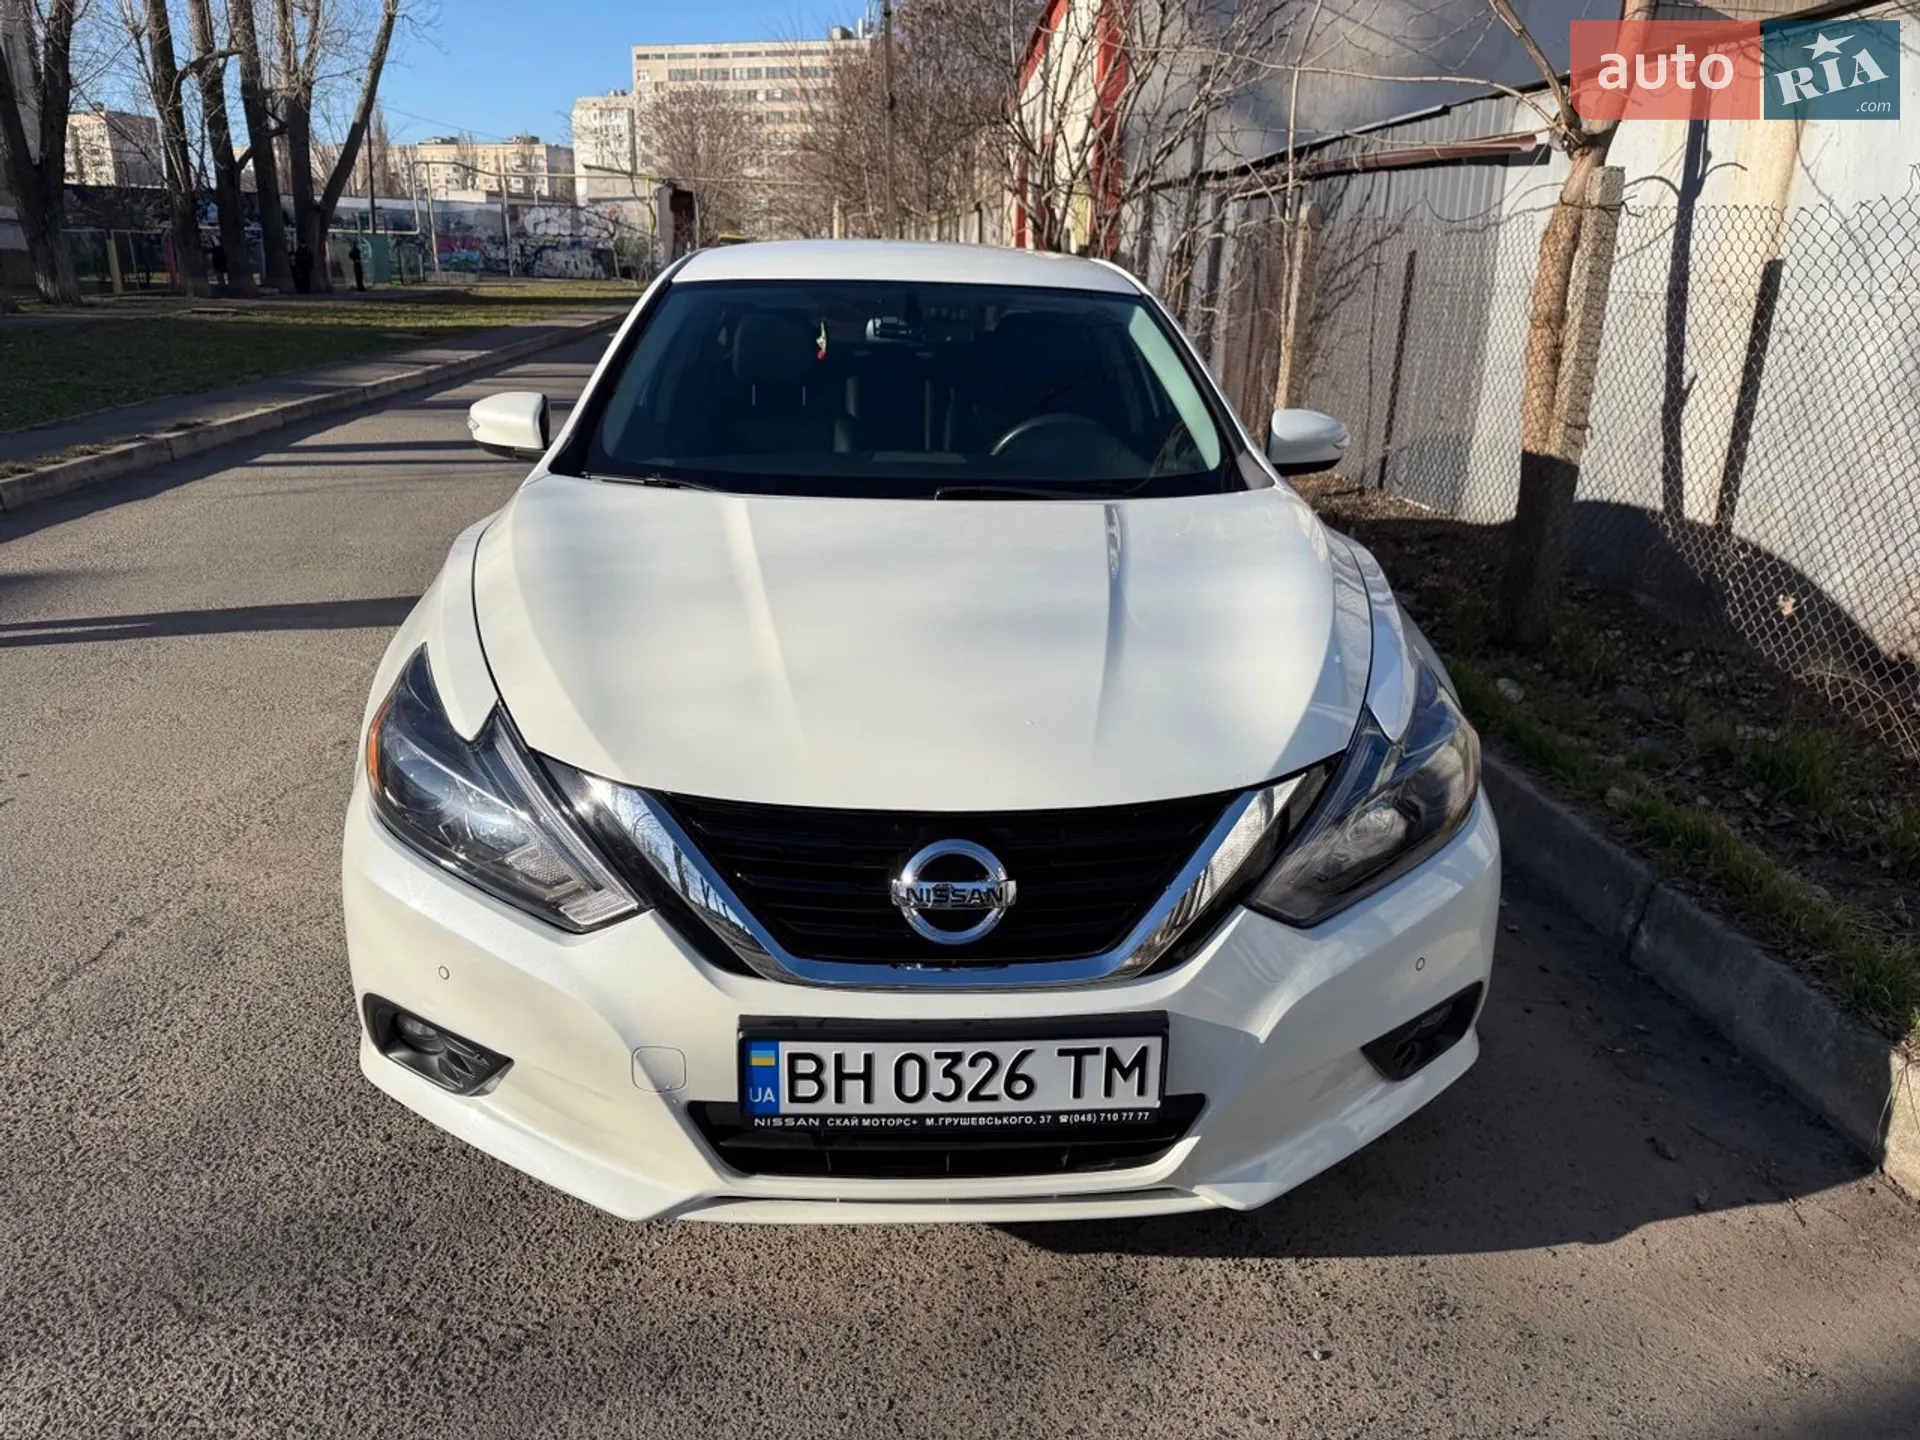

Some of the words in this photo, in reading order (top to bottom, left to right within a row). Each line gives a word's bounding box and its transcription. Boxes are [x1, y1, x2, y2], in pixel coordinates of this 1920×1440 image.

[906, 887, 1003, 904] NISSAN
[786, 1051, 874, 1104] BH
[893, 1048, 1037, 1104] 0326
[1056, 1045, 1149, 1099] TM
[750, 1087, 776, 1103] UA
[754, 1117, 820, 1127] NISSAN
[827, 1116, 859, 1127] СКАЙ
[1039, 1114, 1052, 1124] 37
[1100, 1112, 1119, 1121] 710
[1121, 1111, 1134, 1121] 77
[1137, 1111, 1150, 1120] 77
